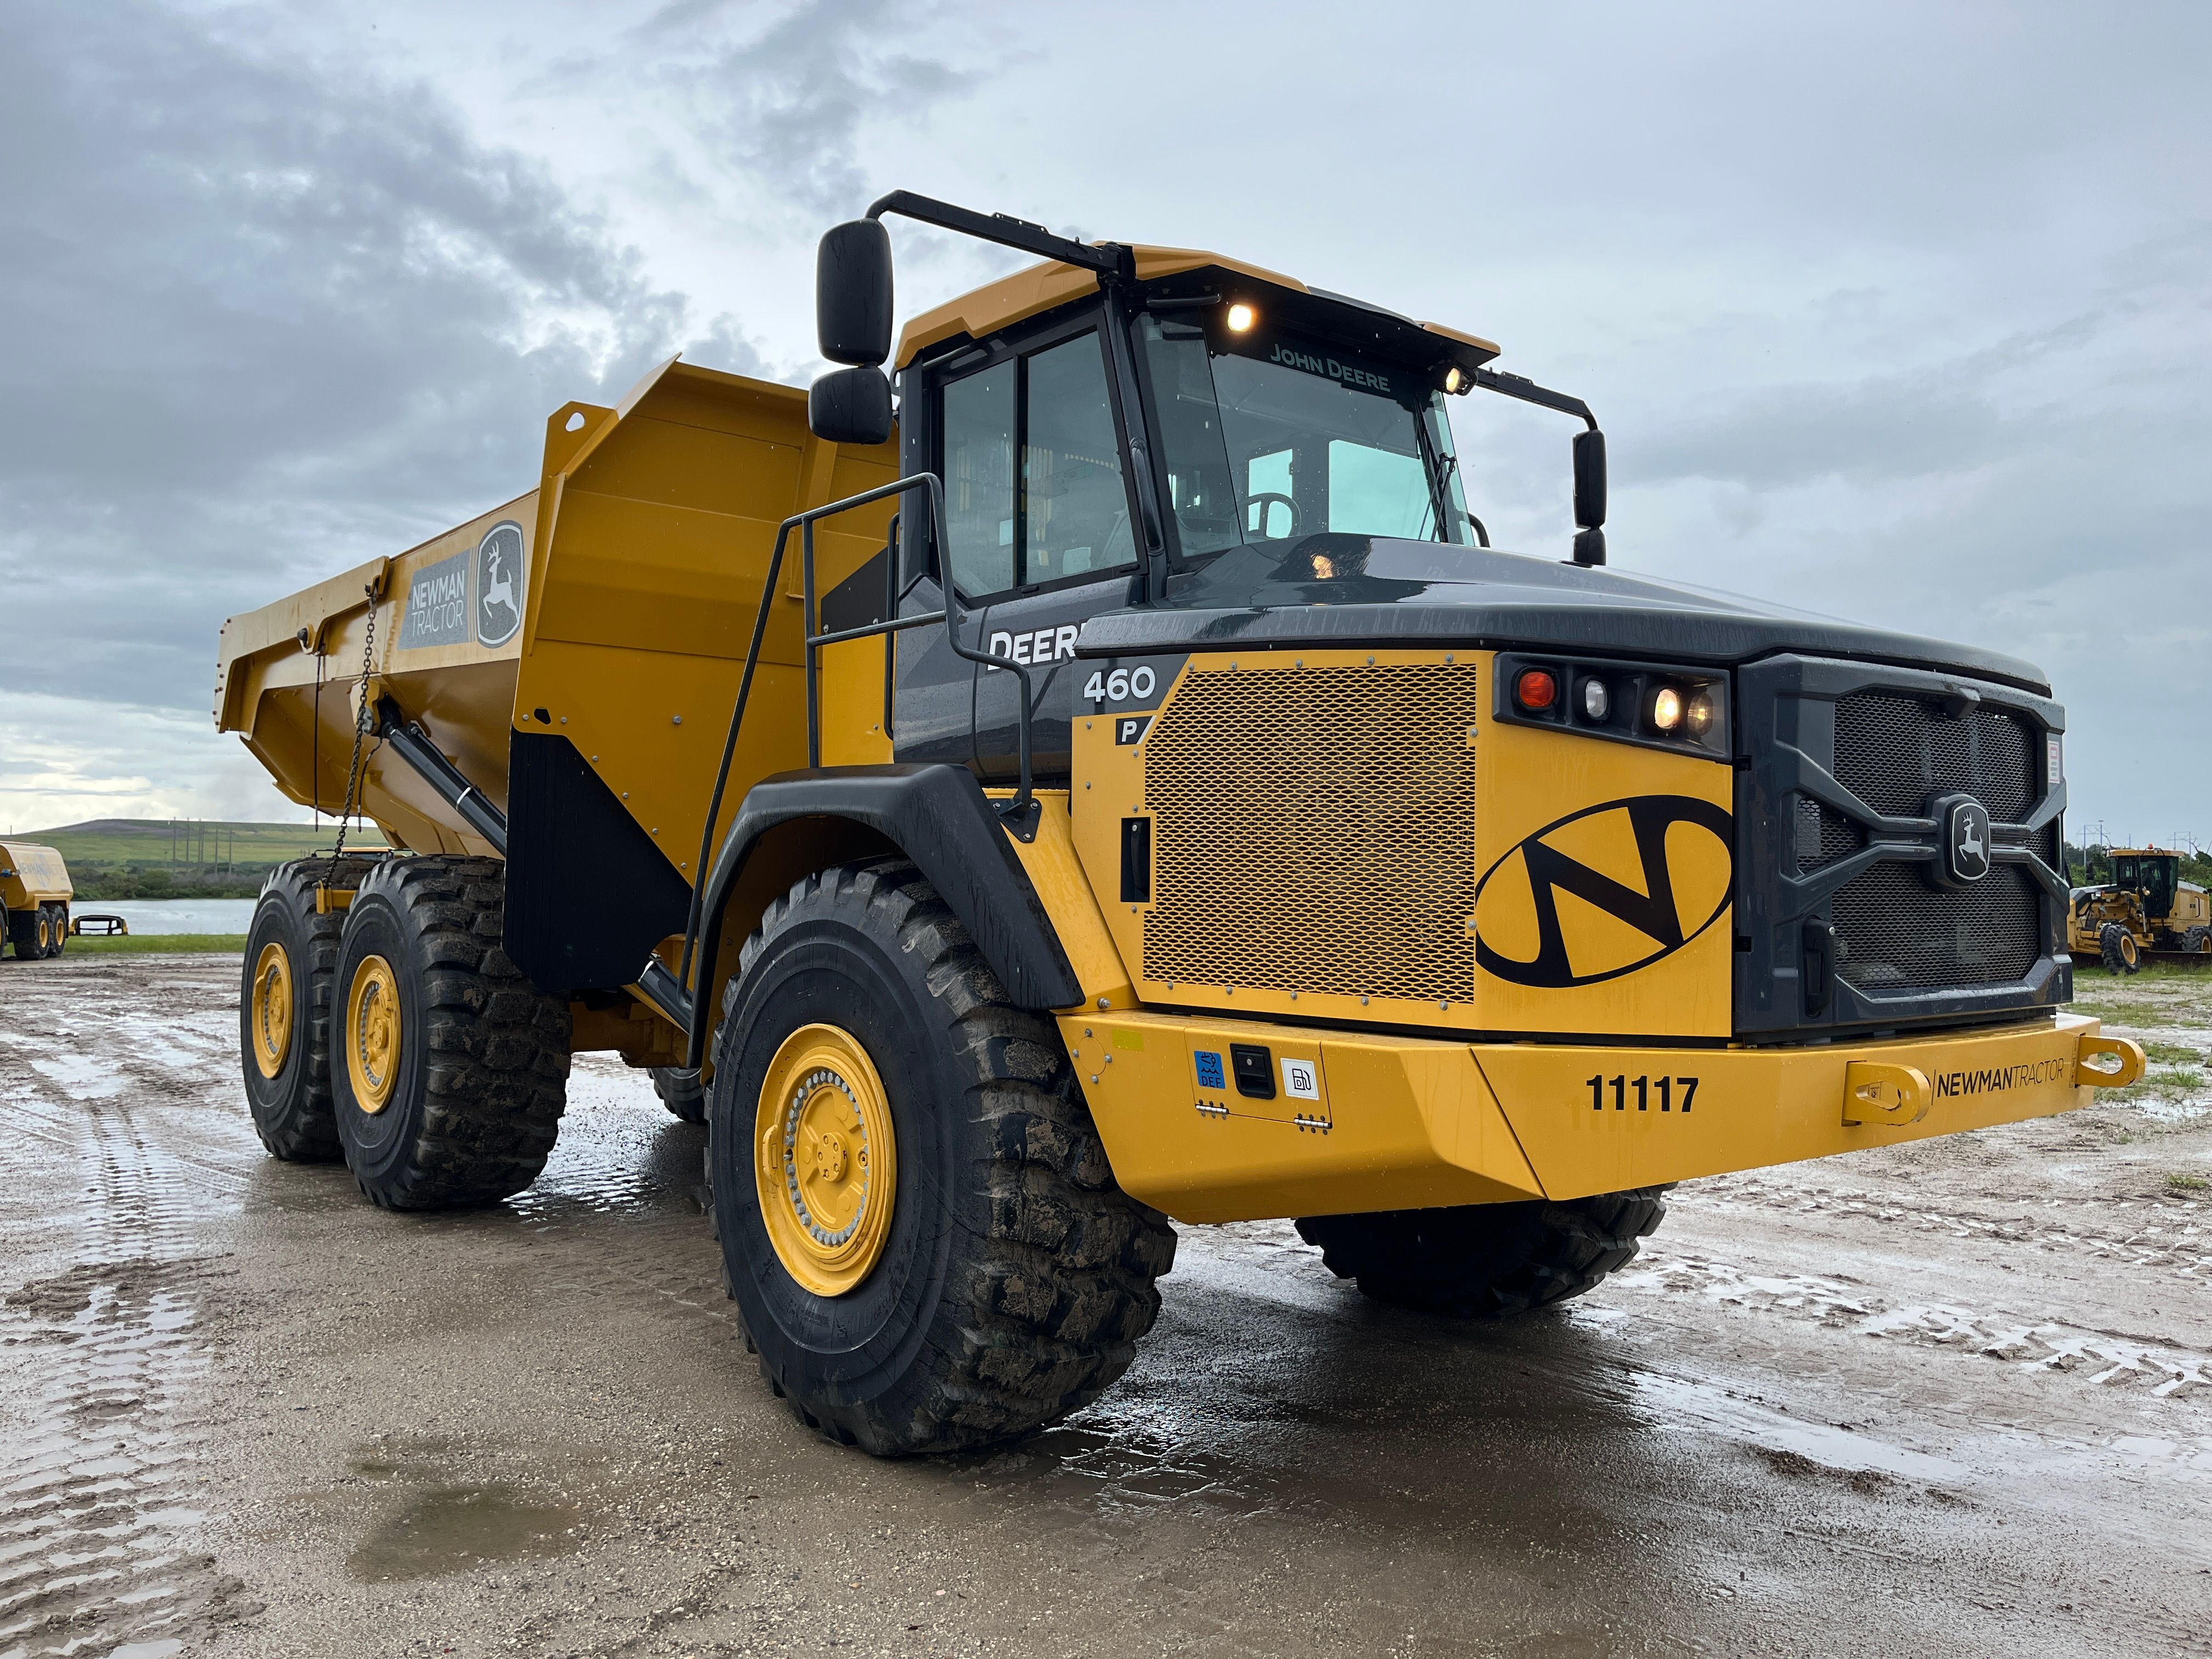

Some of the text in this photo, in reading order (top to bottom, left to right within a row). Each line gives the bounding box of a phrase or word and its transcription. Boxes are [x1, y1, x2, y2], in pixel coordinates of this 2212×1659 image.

[1271, 343, 1391, 392] JOHN DEERE
[412, 570, 465, 610] NEWMAN
[411, 599, 464, 637] TRACTOR
[987, 622, 1087, 671] DEER
[1084, 666, 1156, 702] 460
[1201, 1076, 1221, 1088] DEF
[1586, 1075, 1699, 1113] 11117
